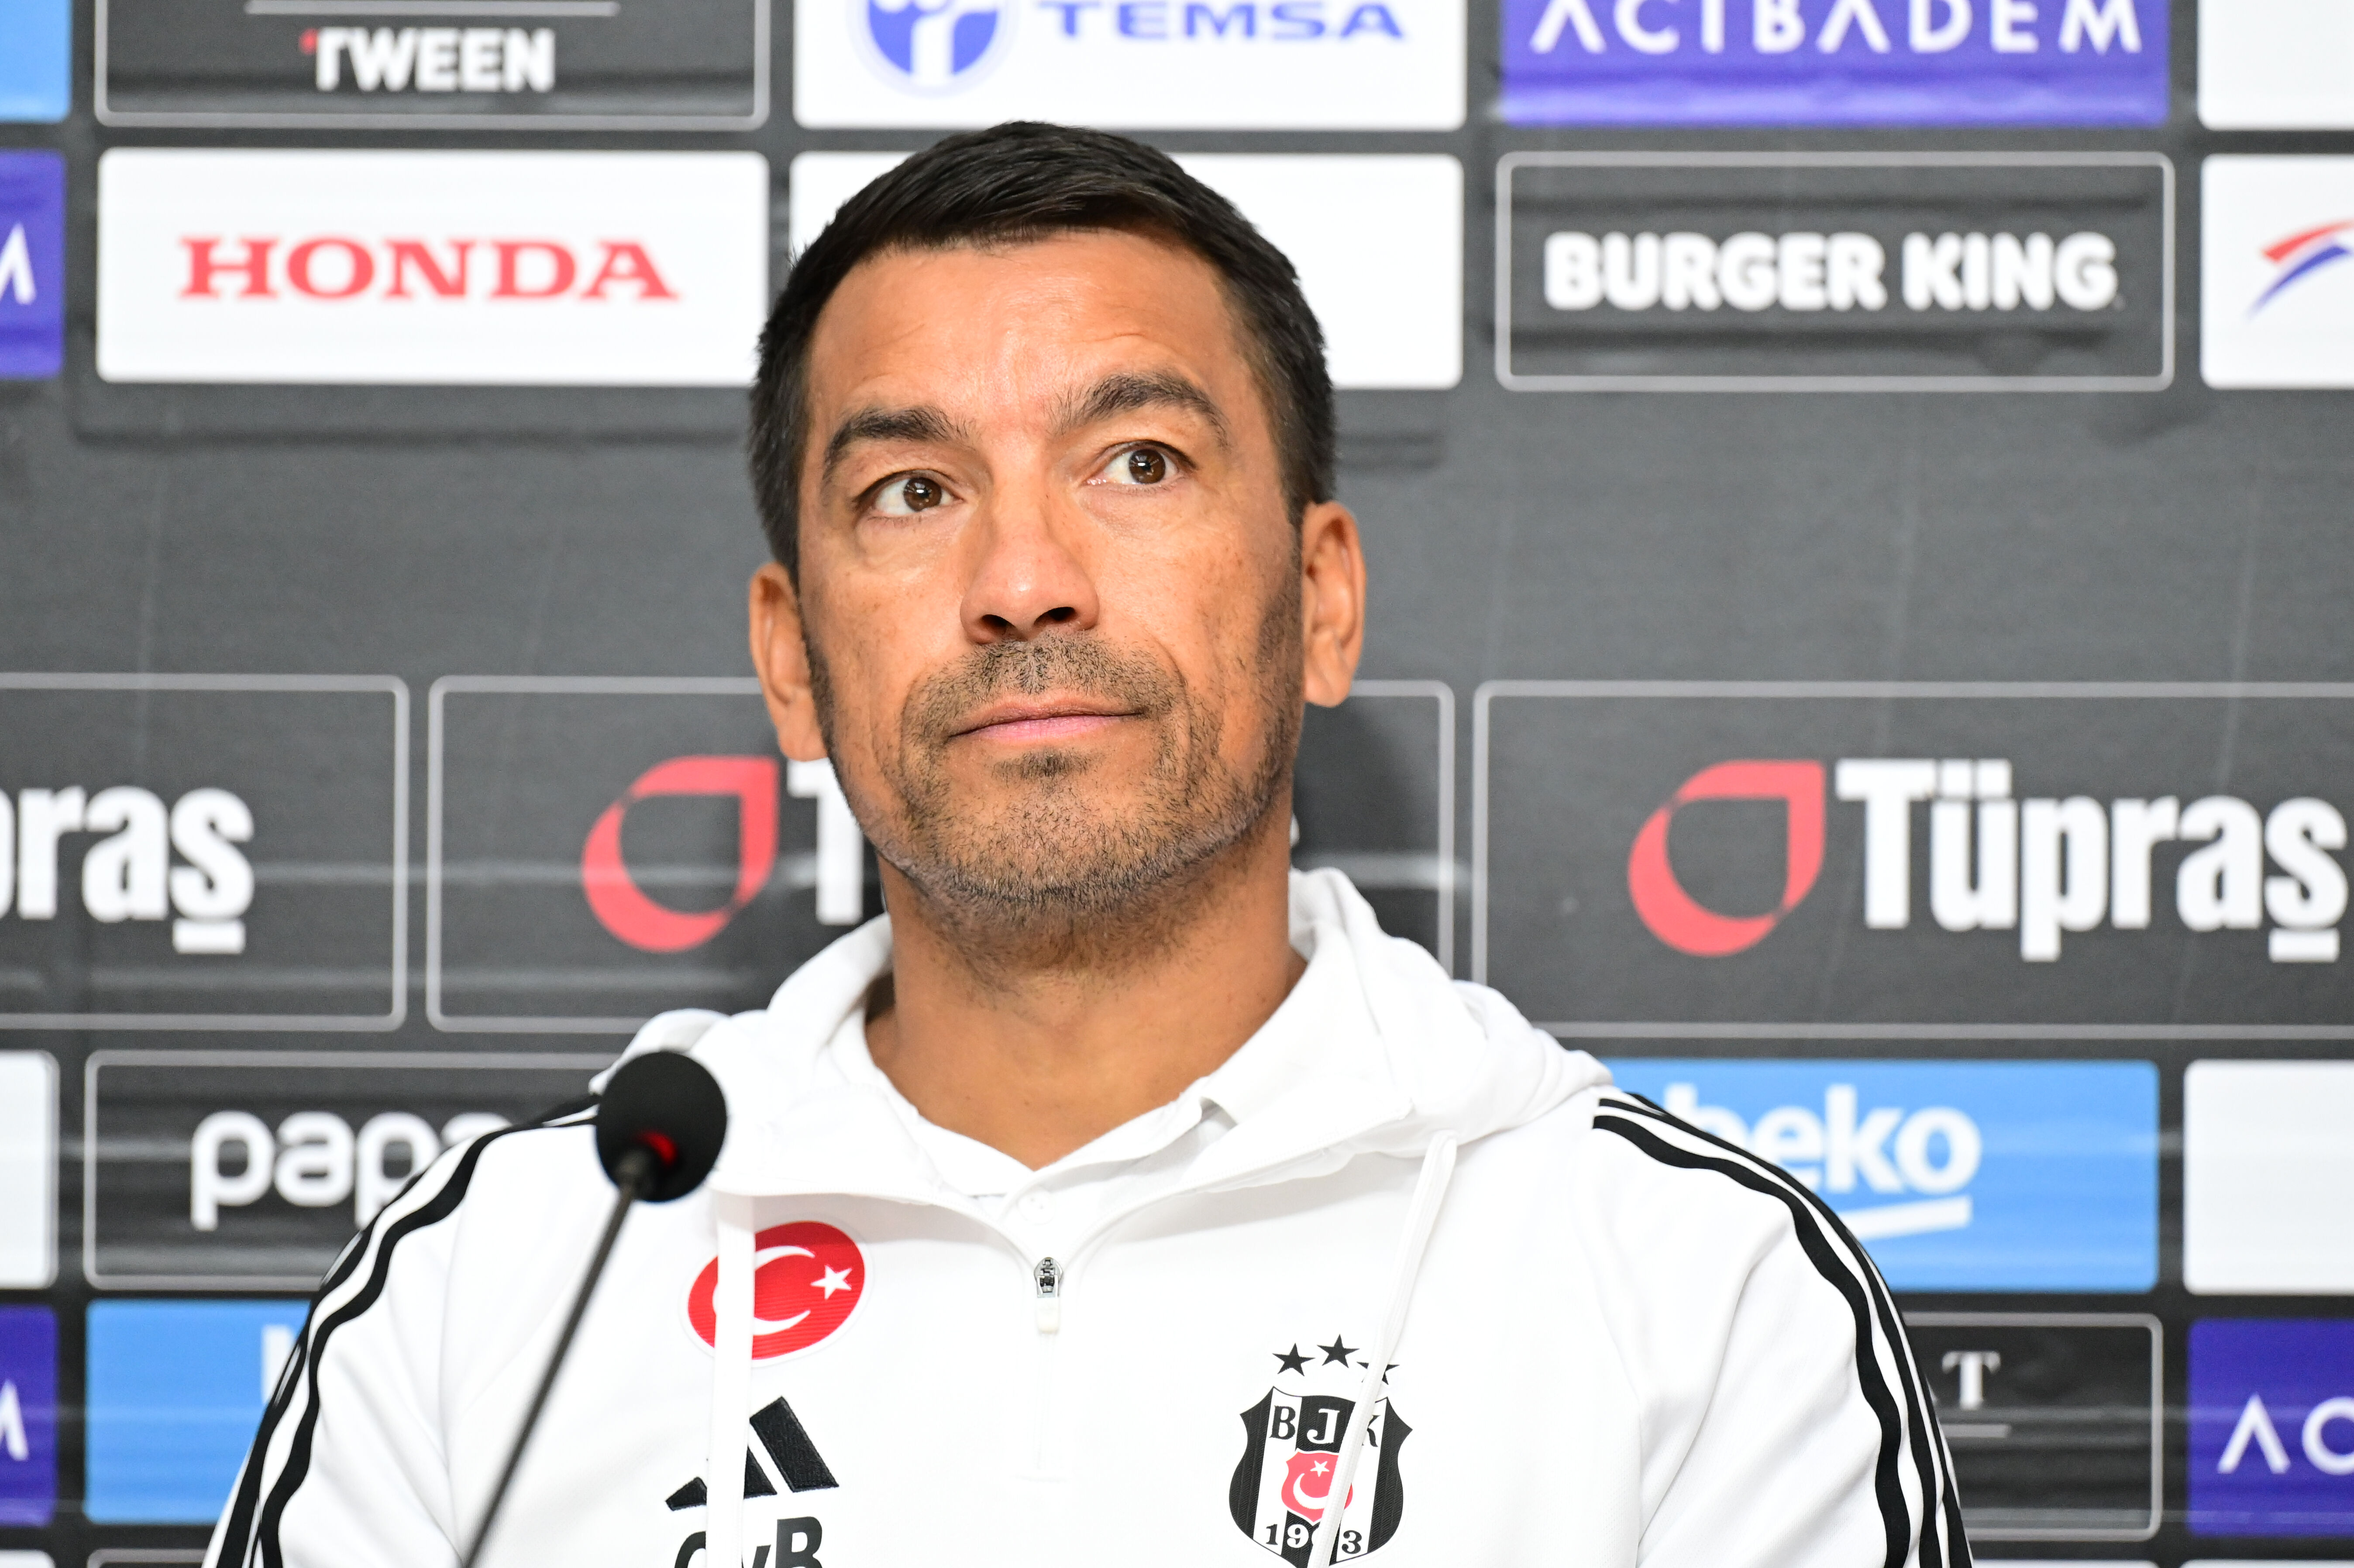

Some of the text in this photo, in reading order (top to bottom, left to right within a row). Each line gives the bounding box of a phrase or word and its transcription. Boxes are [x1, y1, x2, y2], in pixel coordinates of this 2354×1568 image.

[1039, 0, 1404, 40] TEMSA
[299, 27, 555, 93] TWEEN
[178, 236, 680, 301] HONDA
[1543, 230, 2118, 312] BURGER KING
[0, 785, 255, 955] raş
[1834, 759, 2350, 962] Tüpraş
[1265, 1523, 1363, 1555] 193
